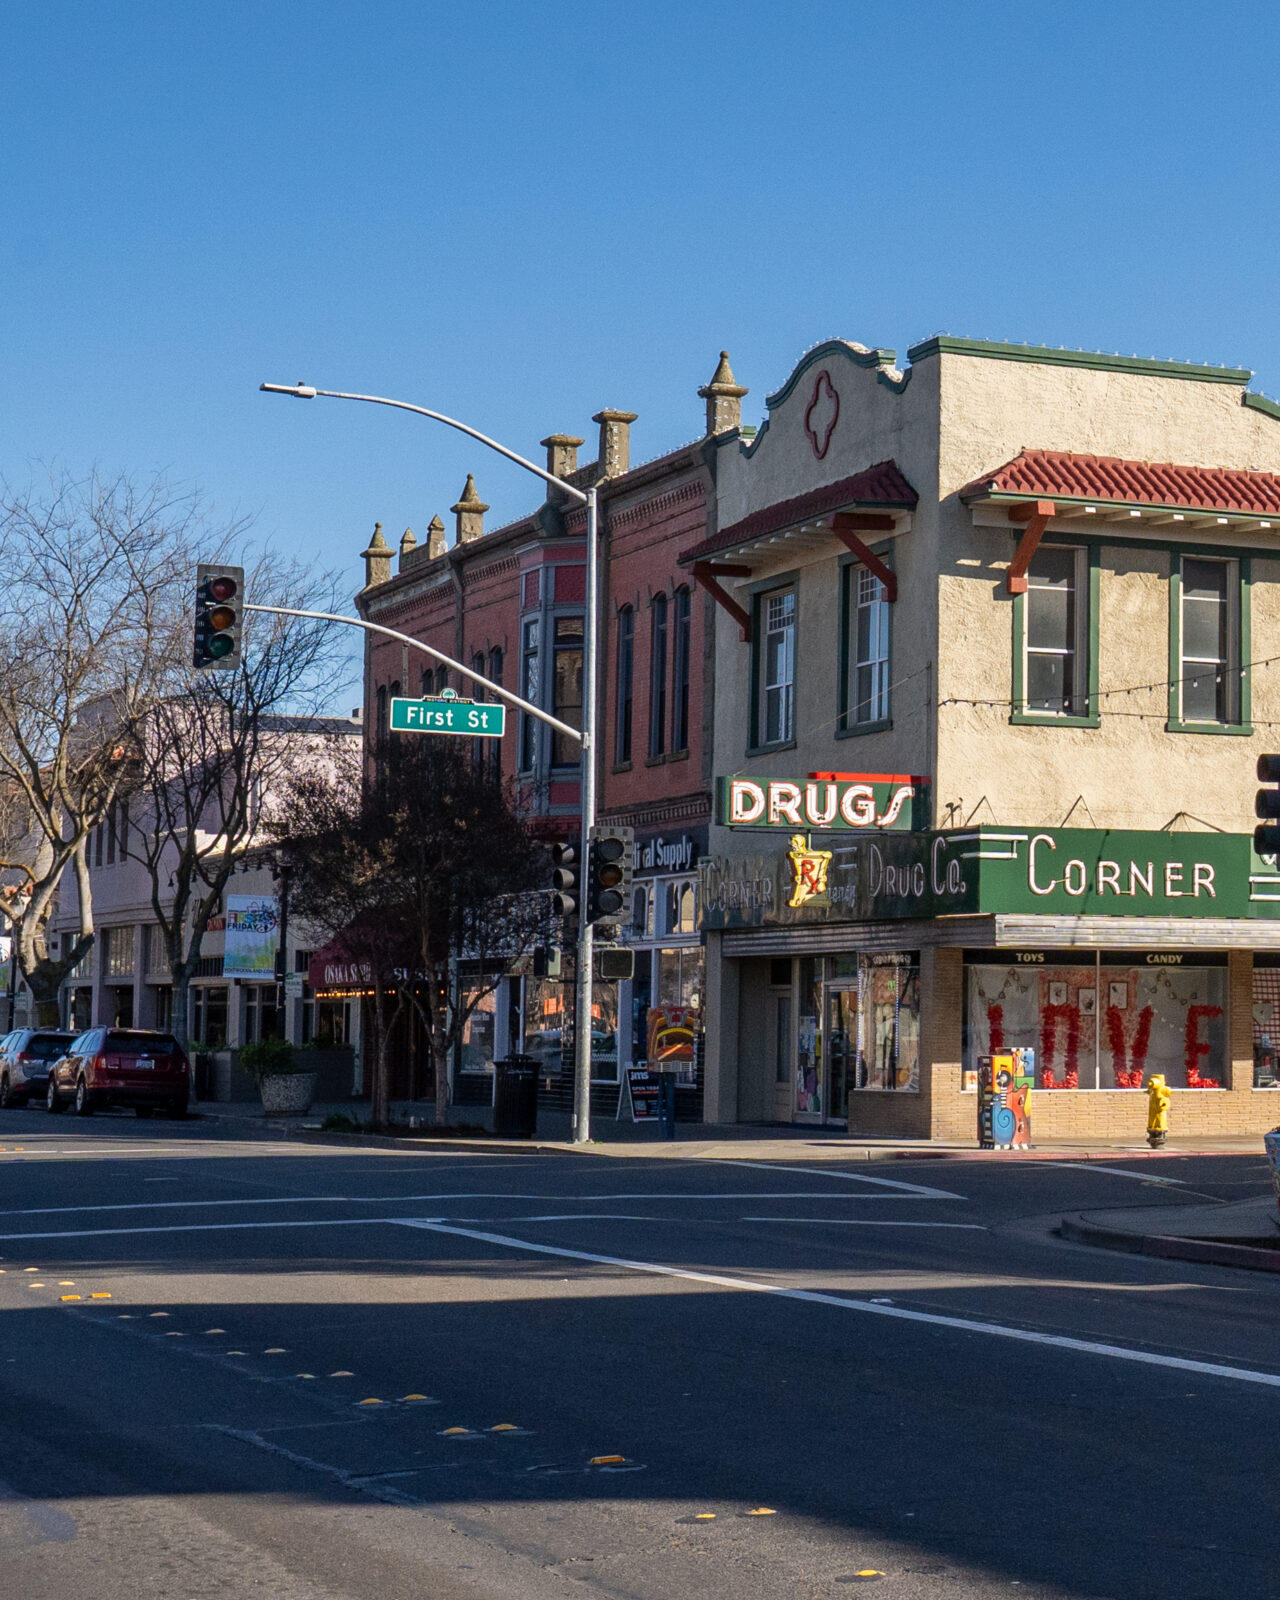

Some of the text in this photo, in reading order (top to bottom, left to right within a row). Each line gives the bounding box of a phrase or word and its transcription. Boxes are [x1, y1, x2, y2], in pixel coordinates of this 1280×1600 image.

[407, 706, 489, 728] First St
[731, 780, 915, 828] DRUGS
[656, 837, 692, 871] Supply
[1028, 833, 1217, 898] CORNER
[869, 843, 925, 898] DRUG
[227, 922, 258, 930] FRIDAY
[1016, 953, 1045, 963] TOYS
[1146, 954, 1183, 965] CANDY
